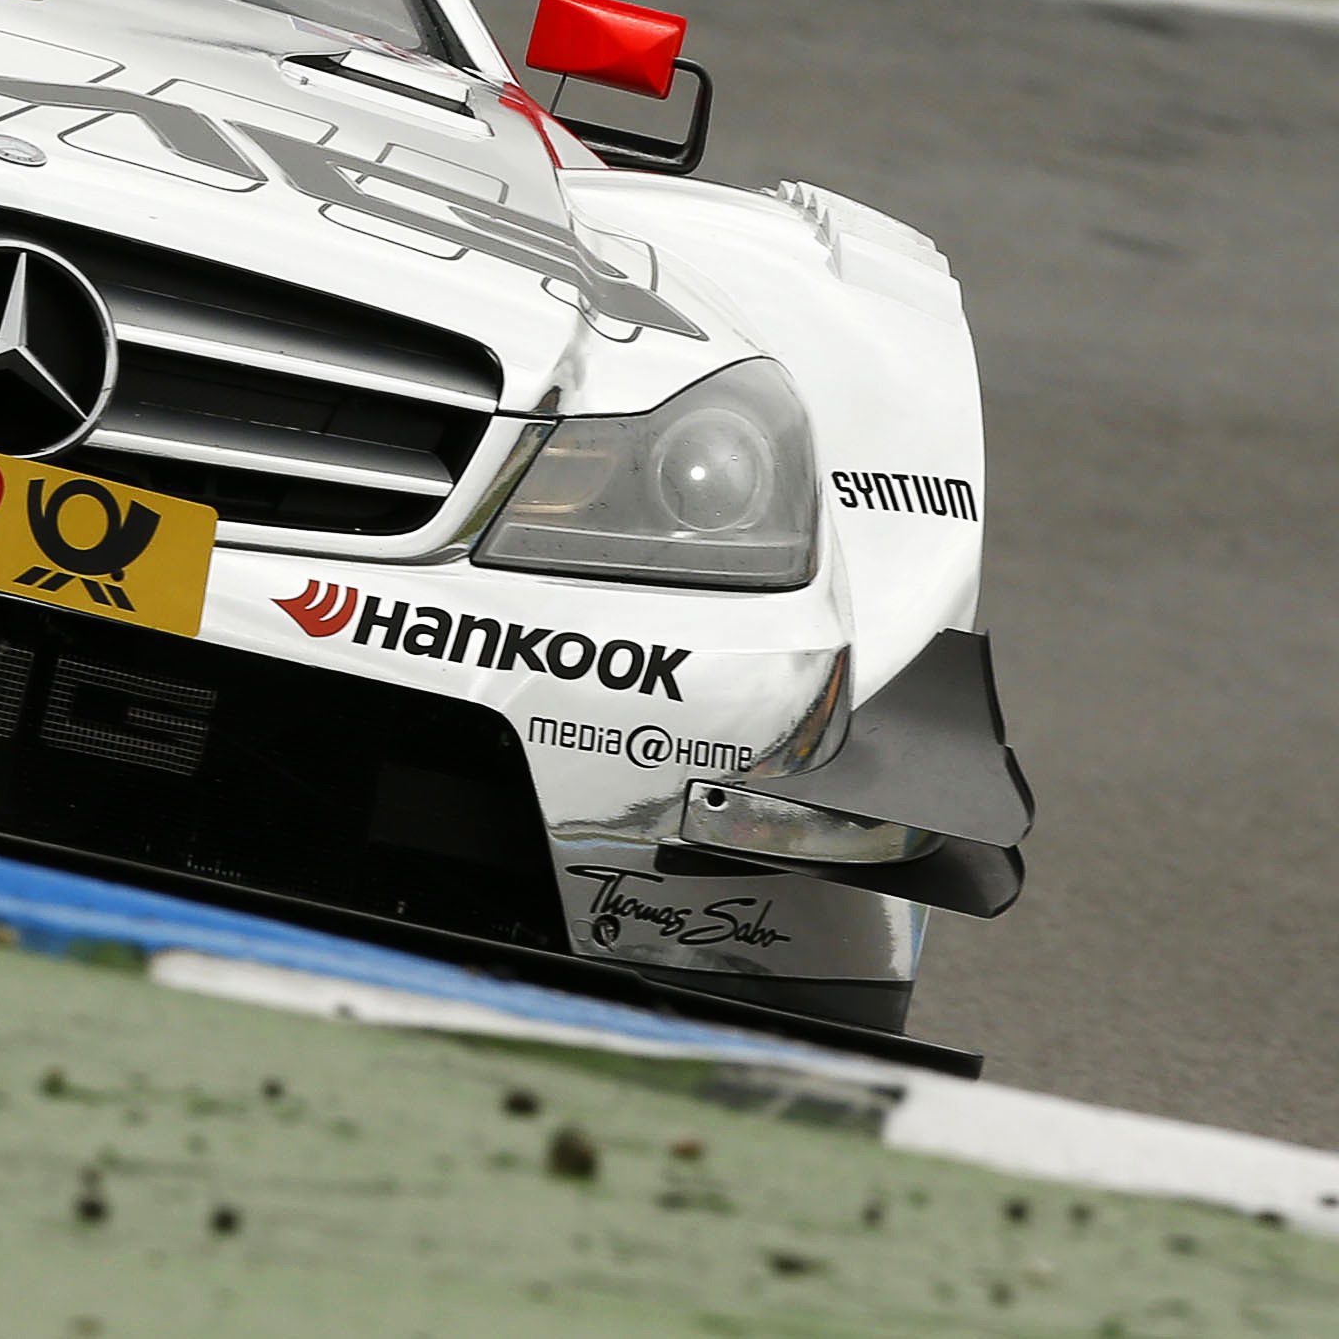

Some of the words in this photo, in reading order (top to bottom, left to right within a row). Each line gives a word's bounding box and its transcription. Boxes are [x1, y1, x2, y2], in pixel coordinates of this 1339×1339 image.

[832, 470, 979, 523] SYNTIUM
[566, 863, 687, 934] Thomas
[684, 898, 791, 947] Sabo
